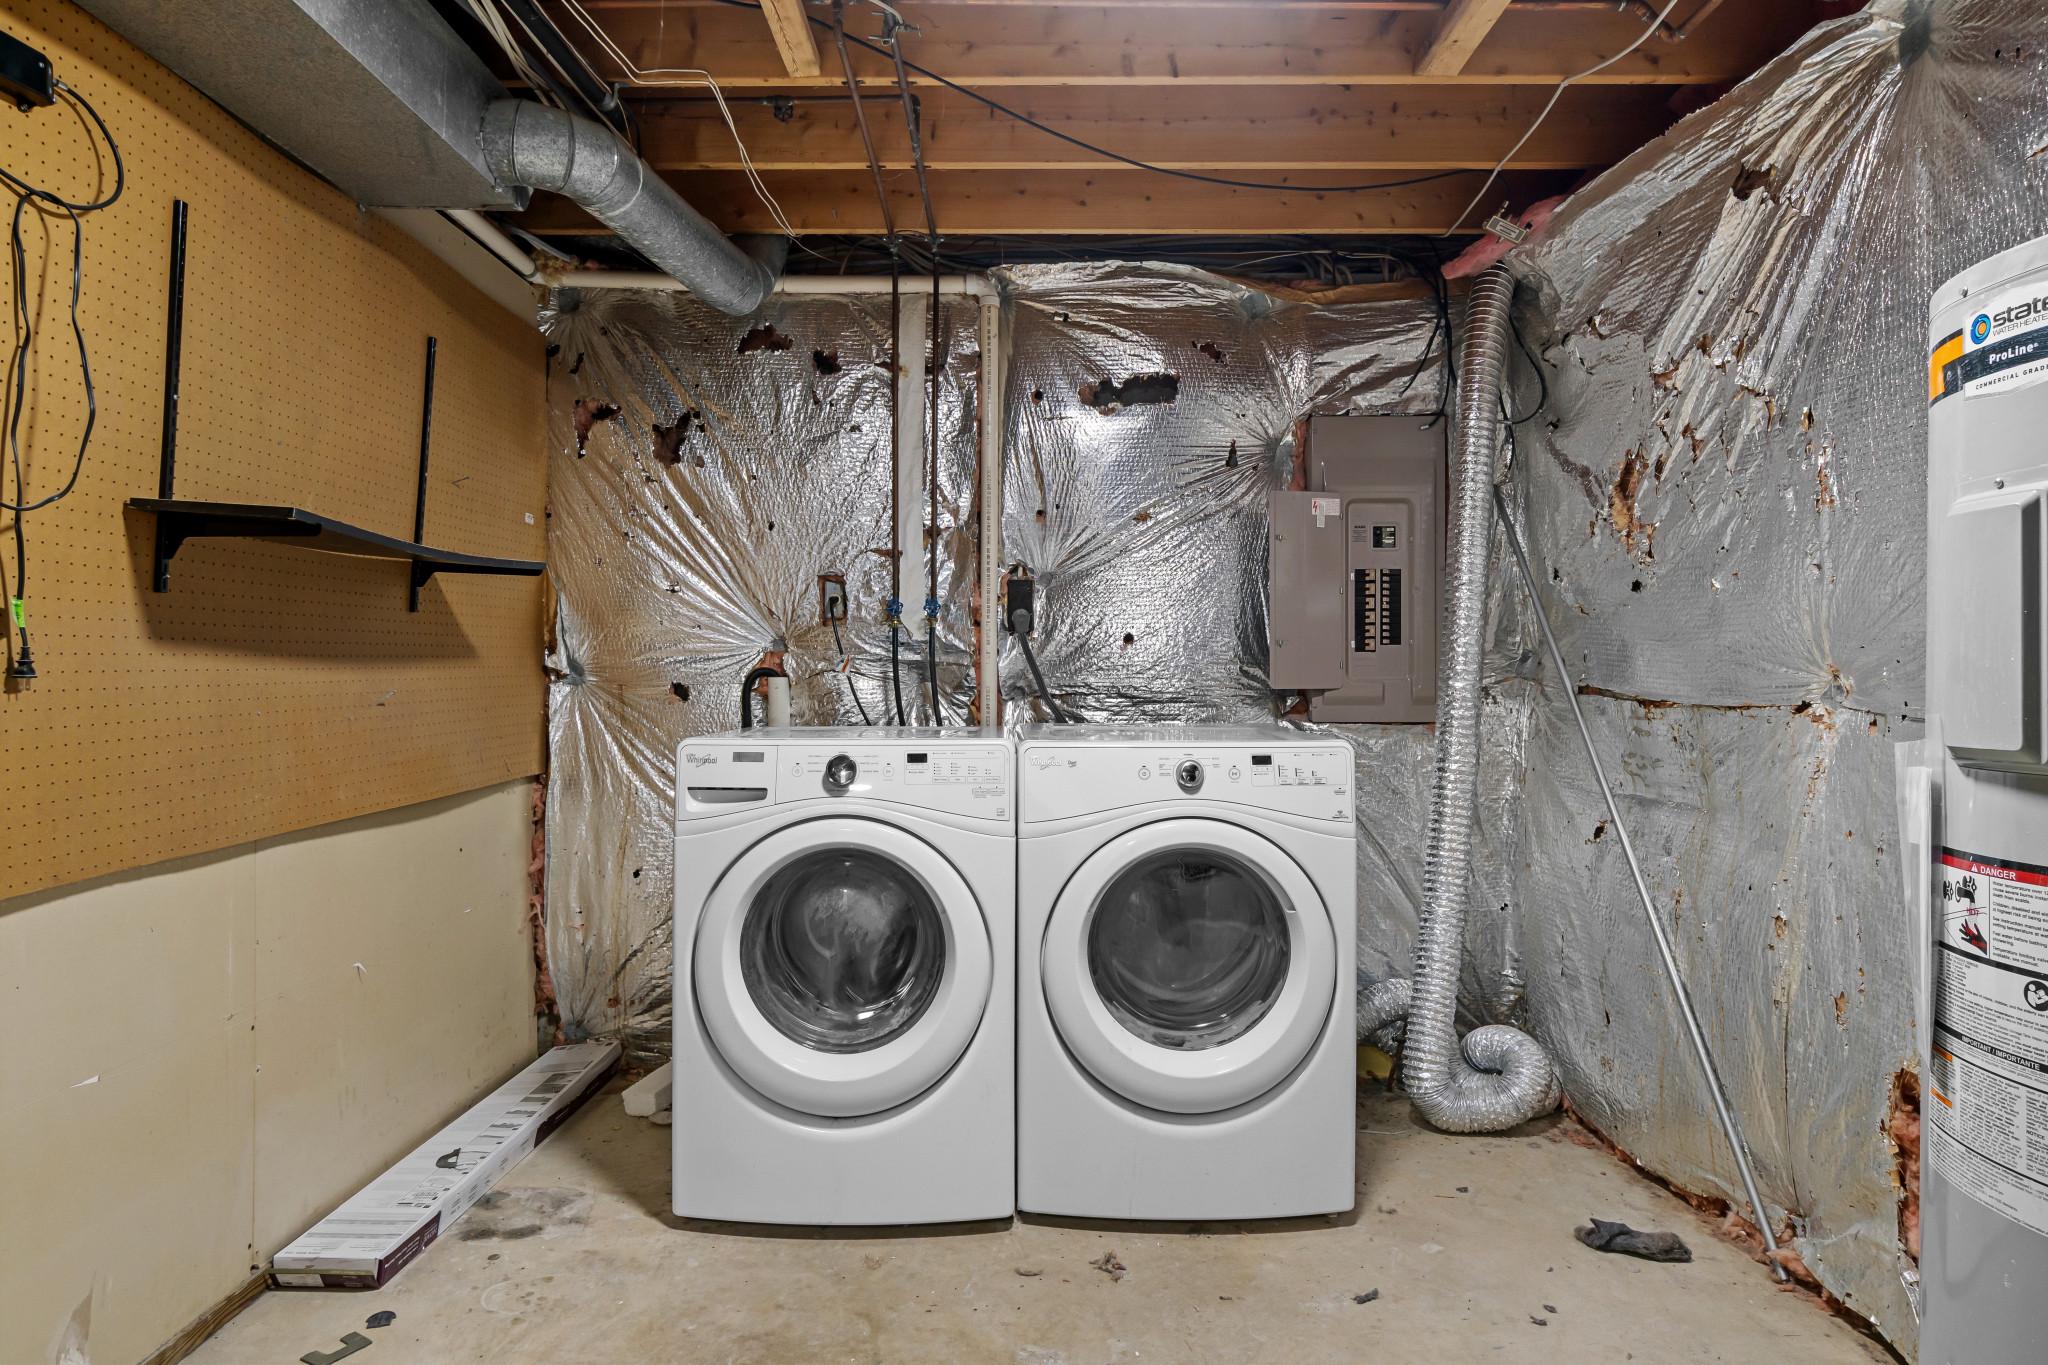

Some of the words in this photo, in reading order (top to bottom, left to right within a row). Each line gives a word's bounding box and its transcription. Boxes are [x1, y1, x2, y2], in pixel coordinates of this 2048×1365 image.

[1993, 322, 2018, 336] WATER
[2020, 313, 2048, 327] HEATE
[1976, 372, 2019, 390] COMMERCIAL
[1980, 866, 2016, 880] DANGER
[1961, 1035, 1991, 1054] IMPORTANT
[1995, 1049, 2040, 1071] IMPORTANTE
